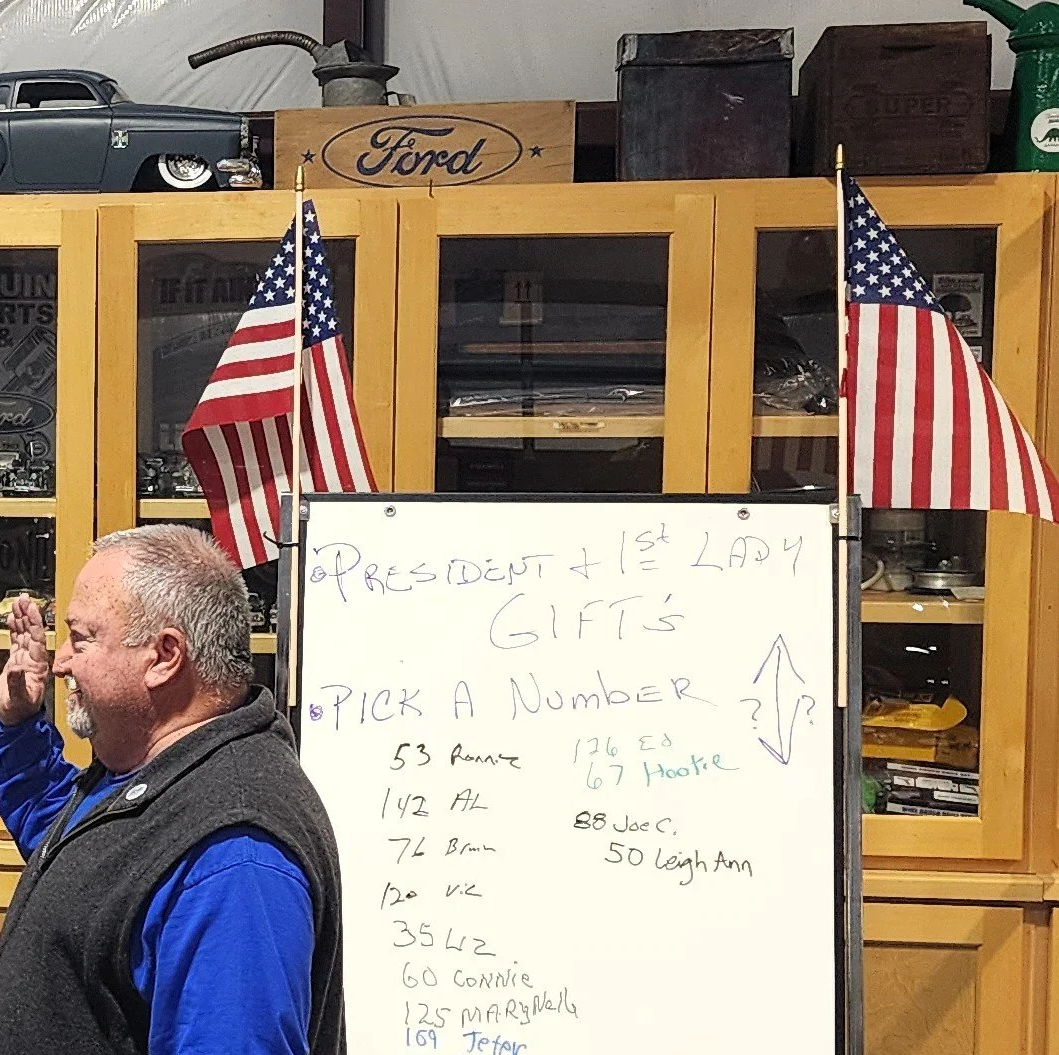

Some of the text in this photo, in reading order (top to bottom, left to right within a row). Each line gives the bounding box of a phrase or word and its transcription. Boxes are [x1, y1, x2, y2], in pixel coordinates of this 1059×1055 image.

[356, 125, 488, 176] Ford
[313, 542, 555, 603] PRESIDENT
[691, 531, 803, 577] LADY
[320, 684, 423, 731] PICK
[454, 680, 474, 720] A
[389, 742, 431, 771] 53
[586, 761, 624, 790] 67
[381, 787, 430, 819] 142
[573, 810, 678, 836] 88 Joe C.
[604, 841, 753, 886] 50 Leigh Ann
[392, 919, 434, 948] 35
[402, 961, 438, 989] 60
[404, 1000, 452, 1029] 125
[406, 1027, 437, 1050] 169
